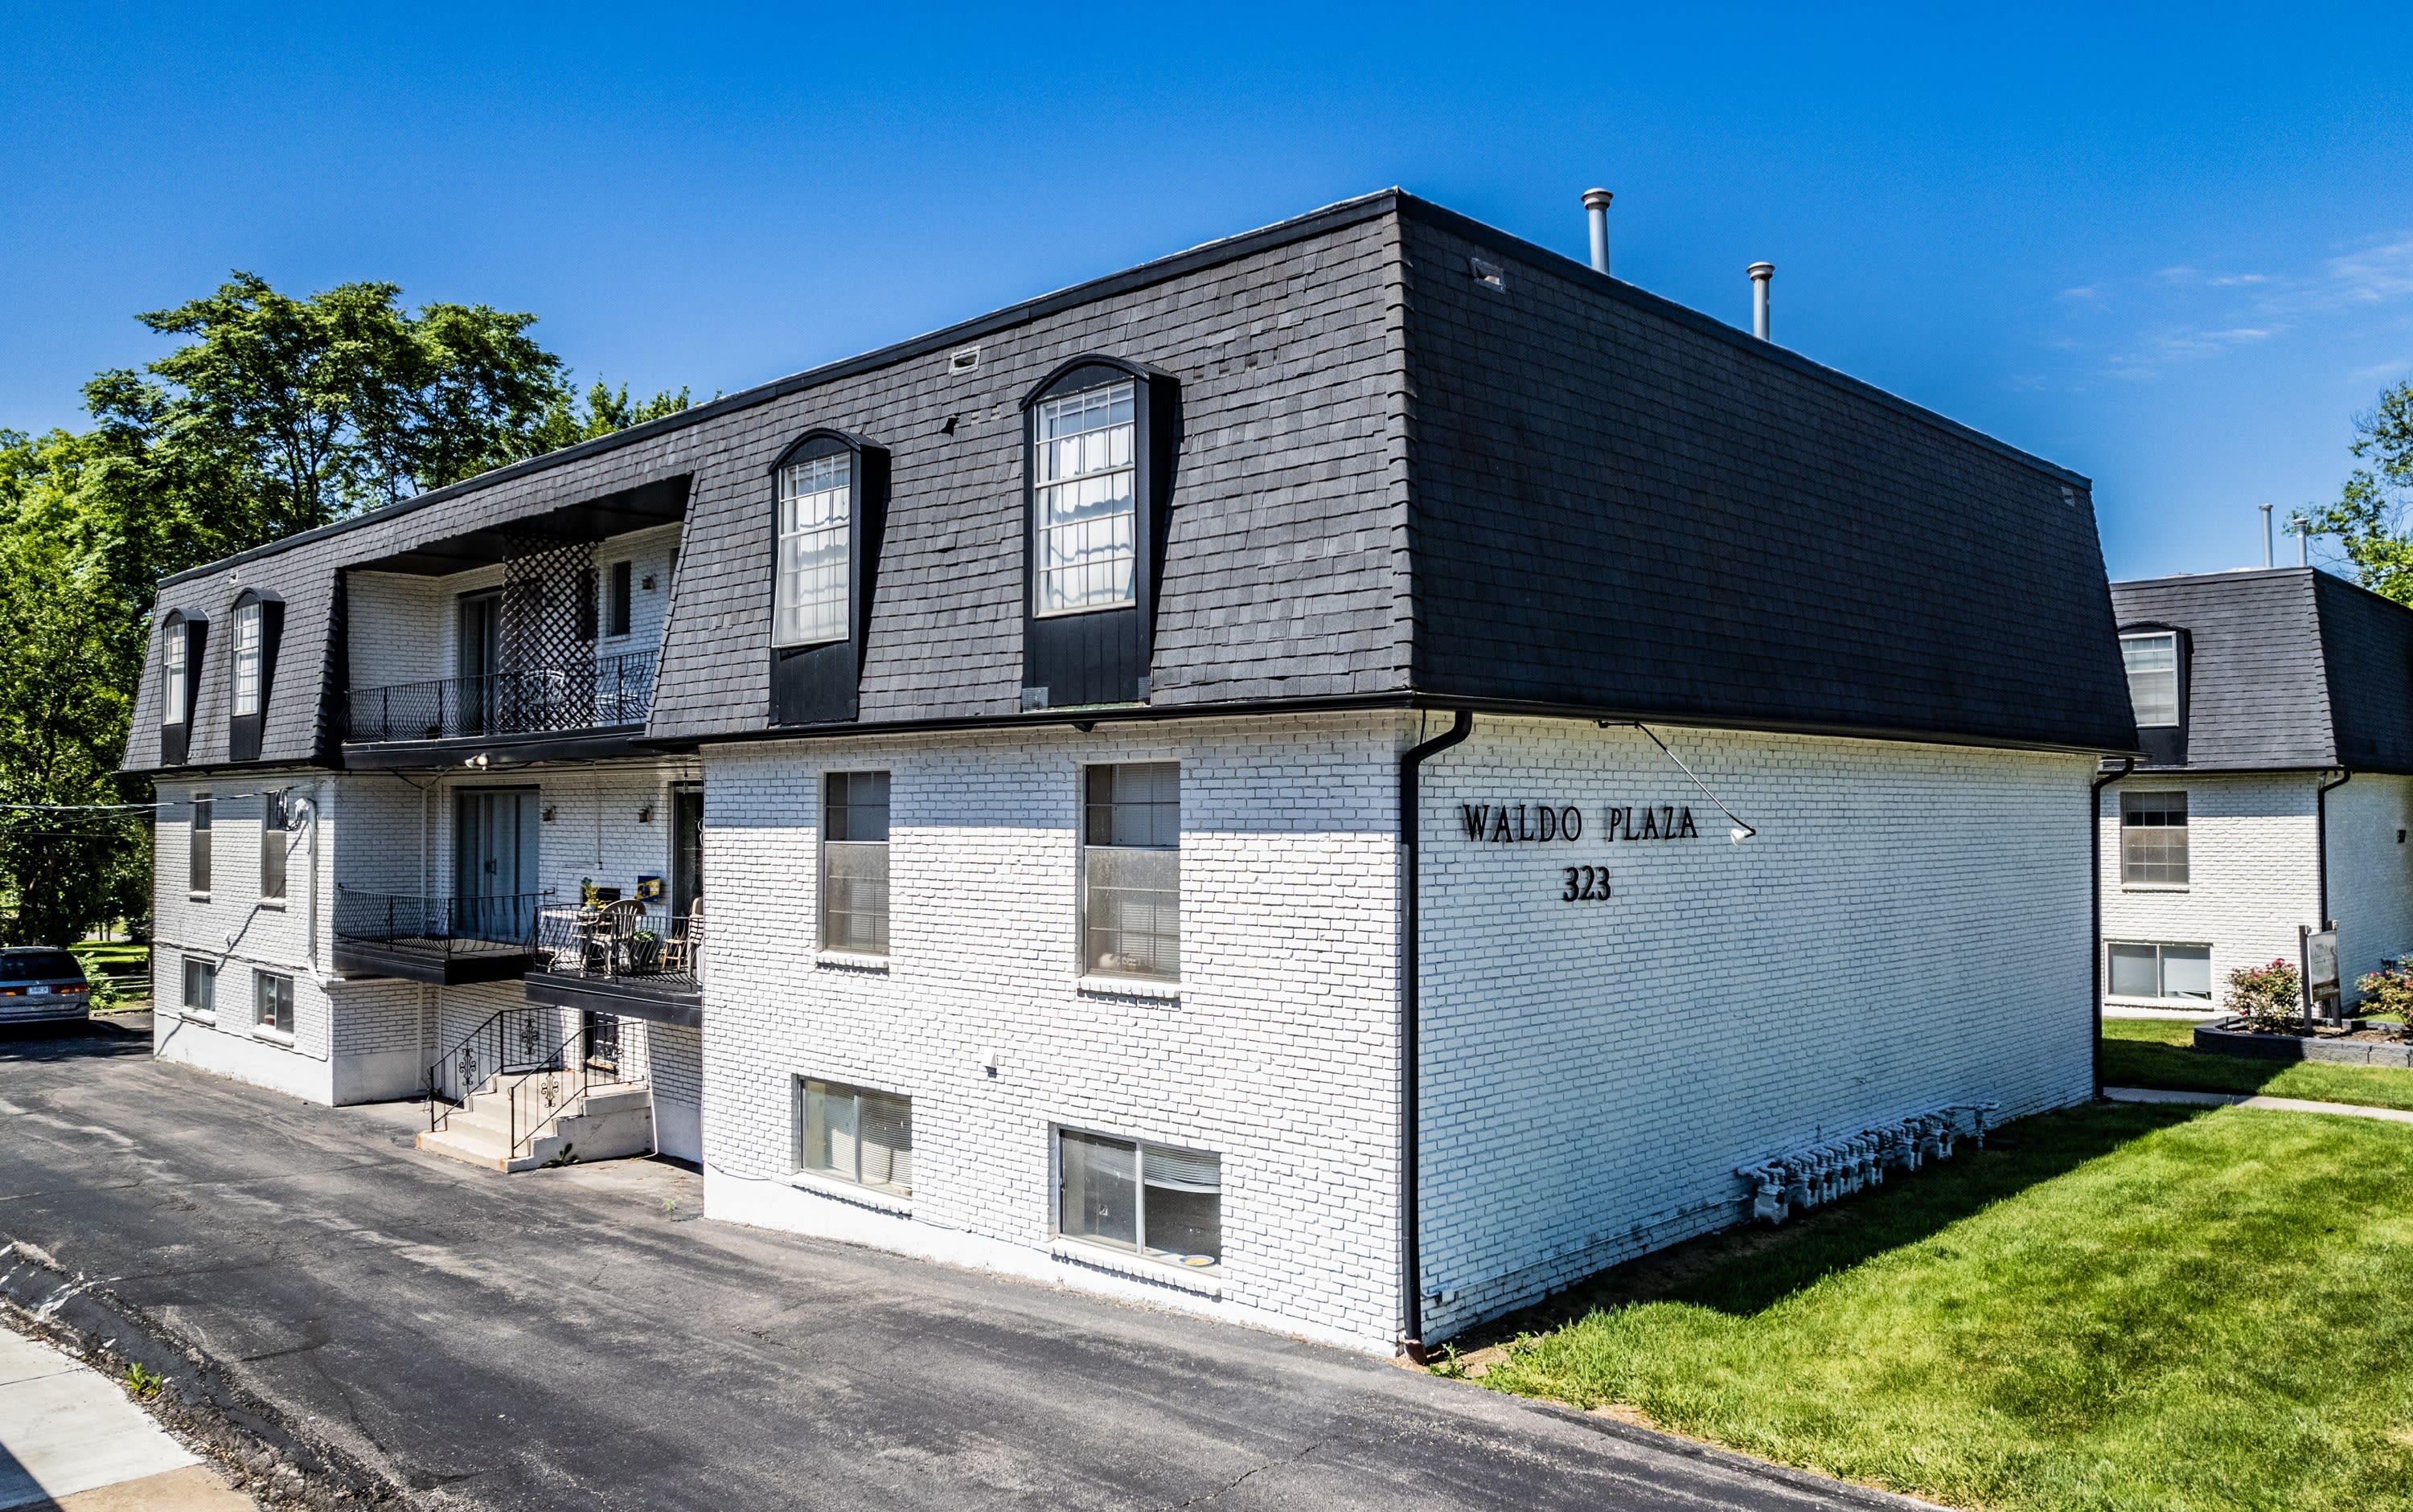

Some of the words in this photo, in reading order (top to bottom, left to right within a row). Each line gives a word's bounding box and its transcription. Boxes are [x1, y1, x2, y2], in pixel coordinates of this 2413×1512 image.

[1463, 805, 1582, 842] WALDO
[1607, 805, 1699, 842] PLAZA
[1562, 865, 1611, 902] 323
